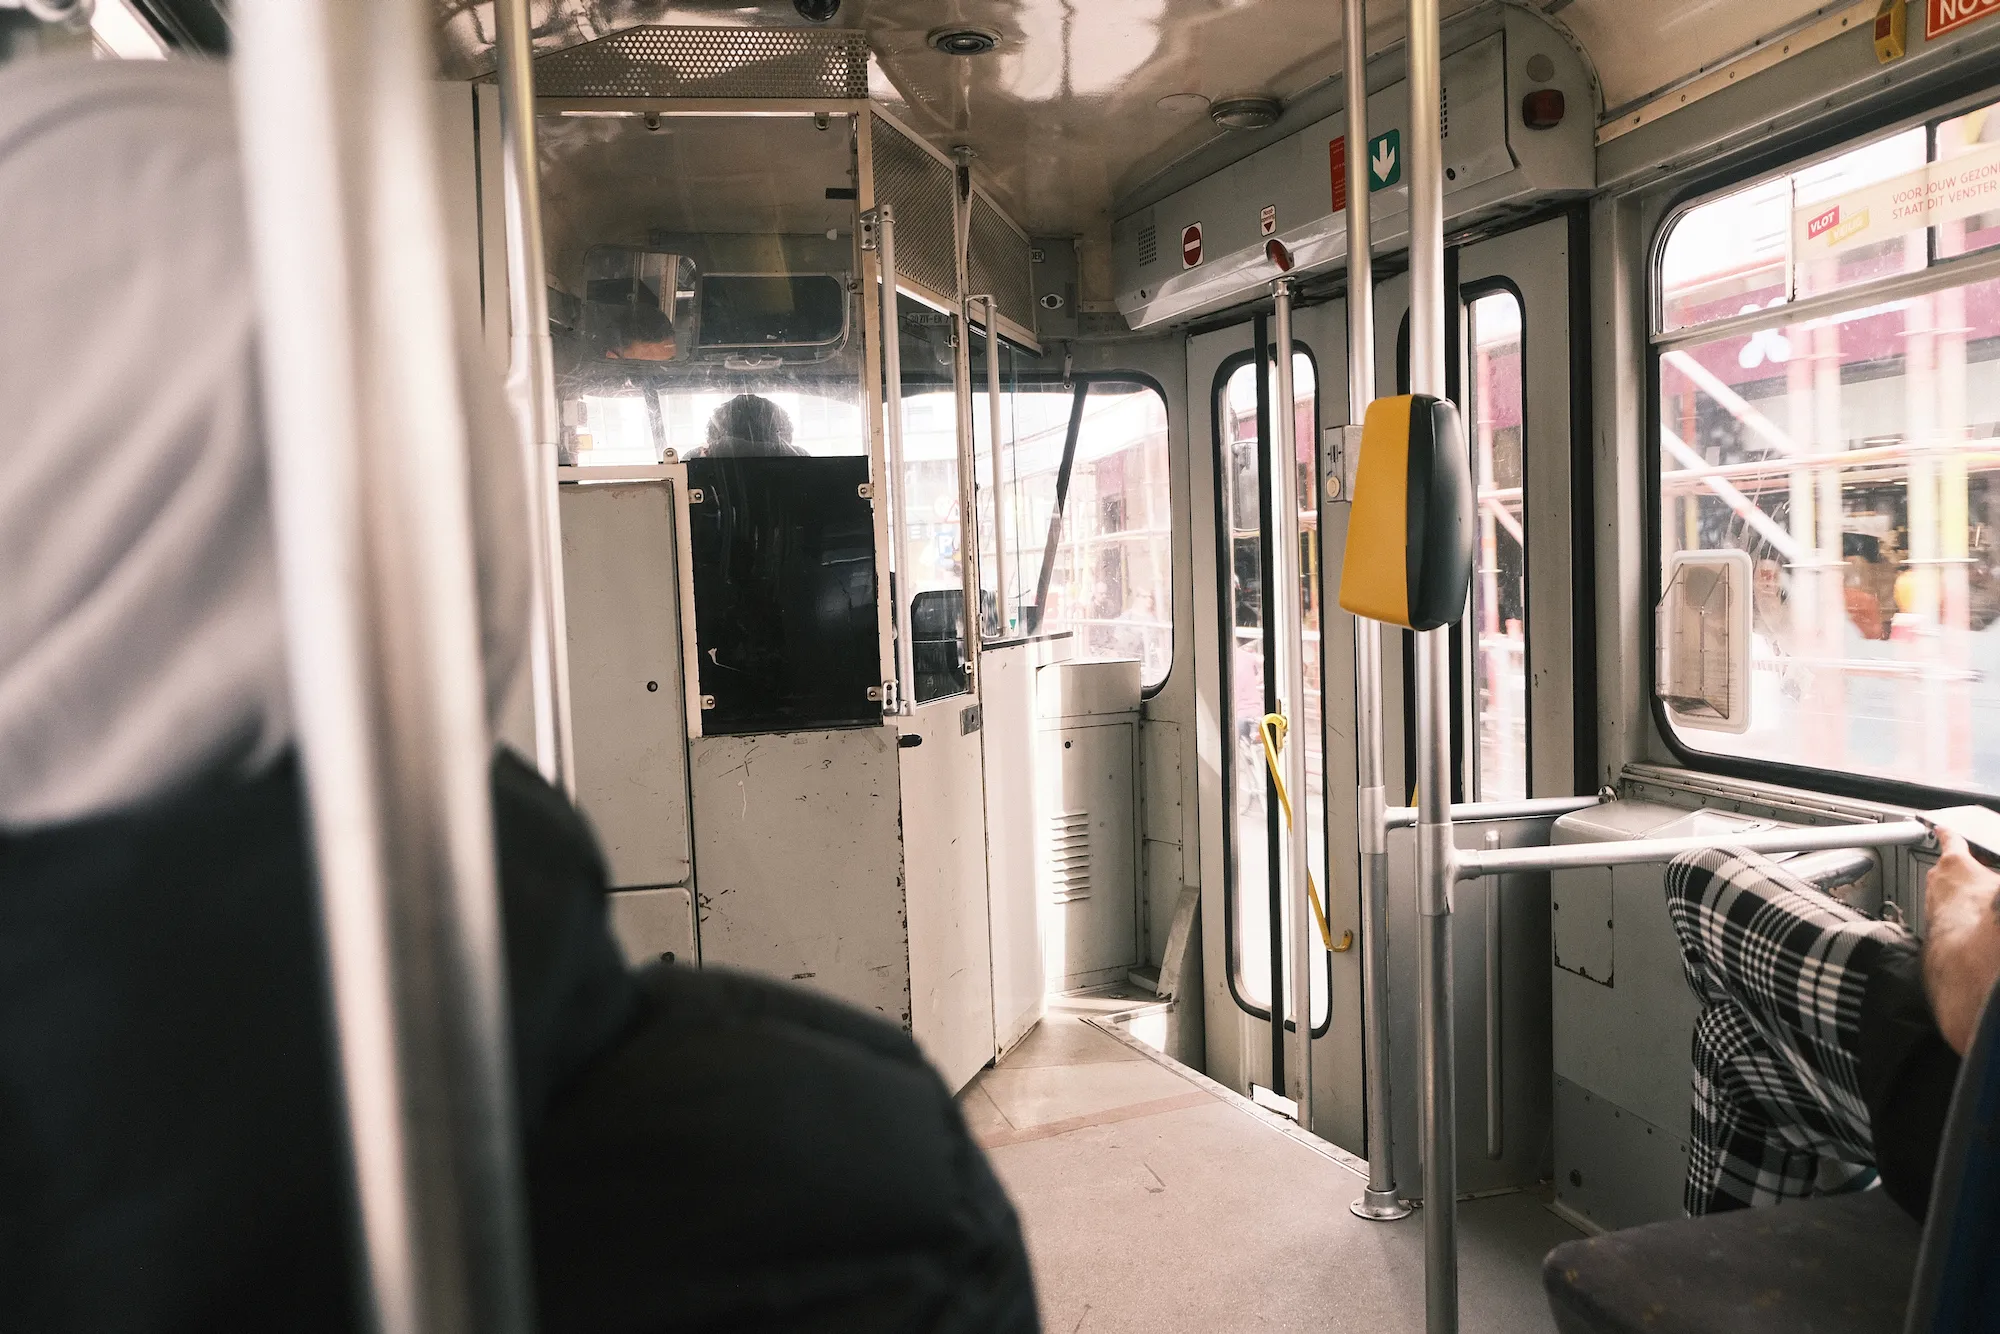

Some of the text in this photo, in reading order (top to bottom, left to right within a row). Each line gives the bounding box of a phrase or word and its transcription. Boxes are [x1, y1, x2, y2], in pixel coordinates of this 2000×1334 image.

[1939, 0, 1995, 25] NO
[1892, 187, 1922, 204] VOOR
[1924, 176, 1957, 195] JOUW
[1892, 180, 1997, 220] STAAT DIT VENSTER
[1810, 211, 1835, 233] VLOT
